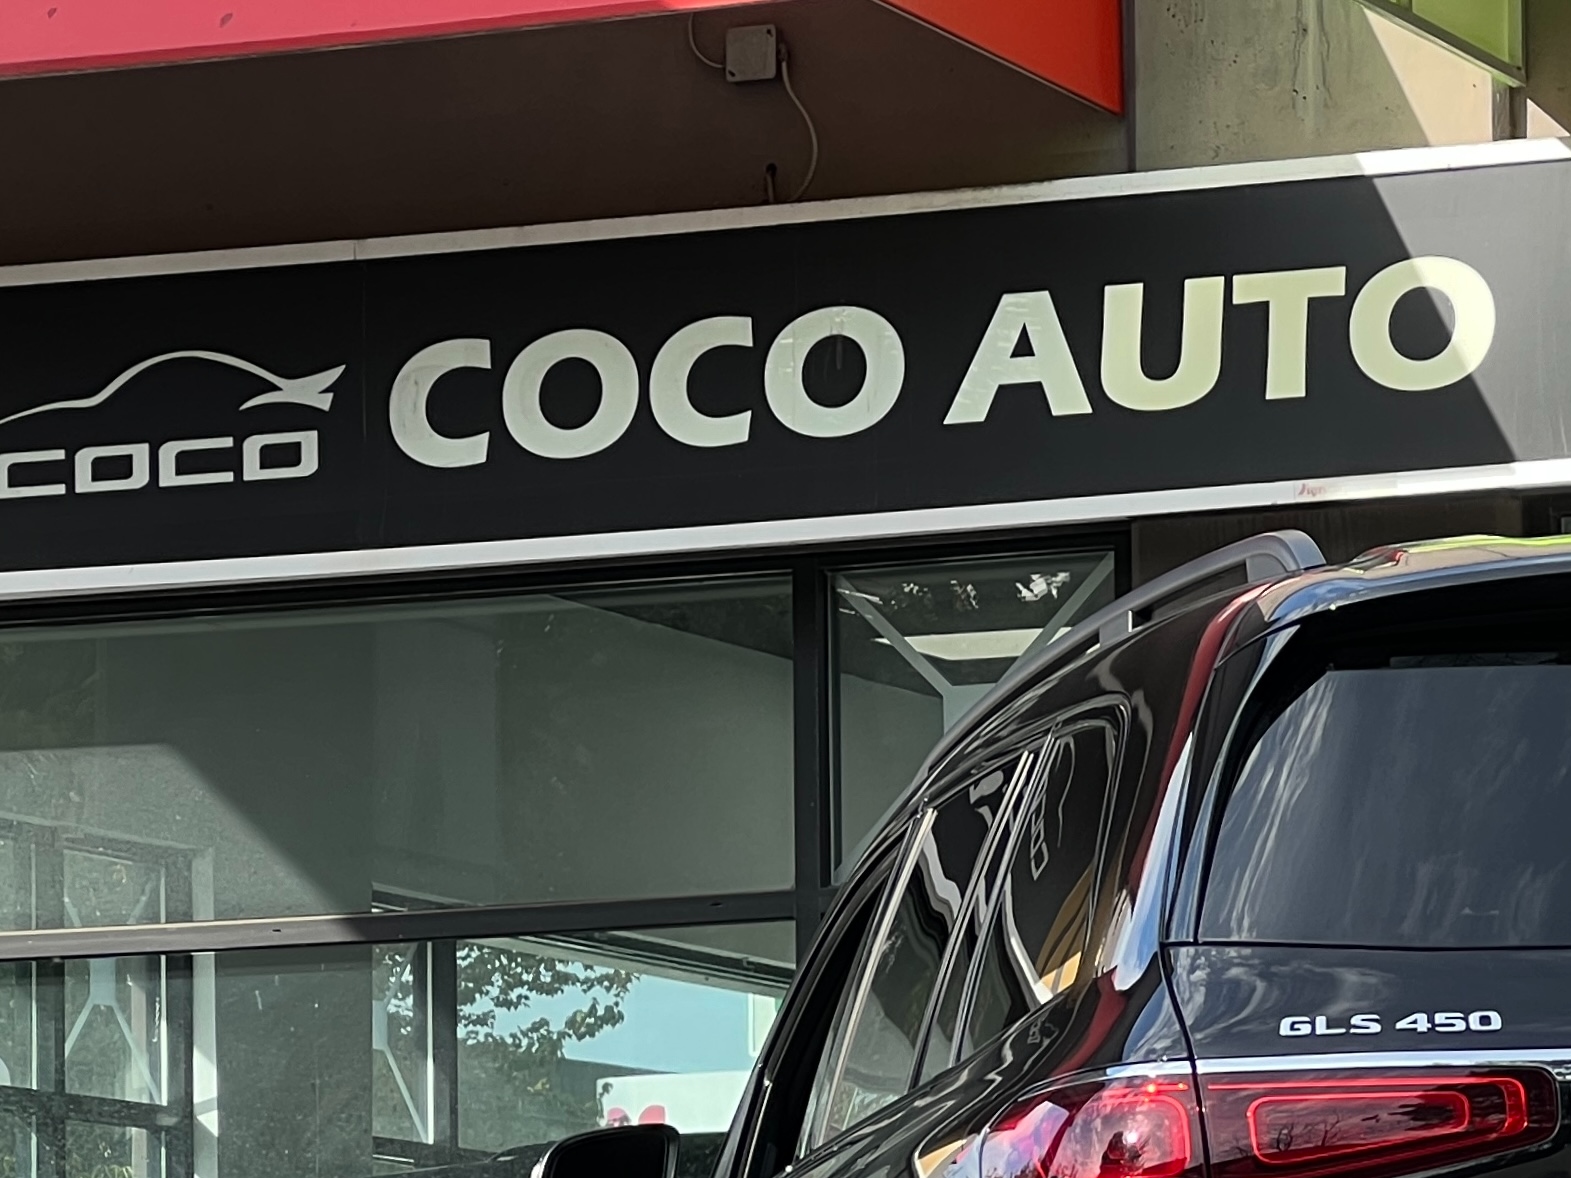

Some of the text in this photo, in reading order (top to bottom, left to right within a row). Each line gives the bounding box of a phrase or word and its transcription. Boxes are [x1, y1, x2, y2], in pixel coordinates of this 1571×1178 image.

[389, 255, 1497, 468] COCO AUTO
[0, 429, 319, 500] COCO
[1279, 1010, 1502, 1036] GLS 450
